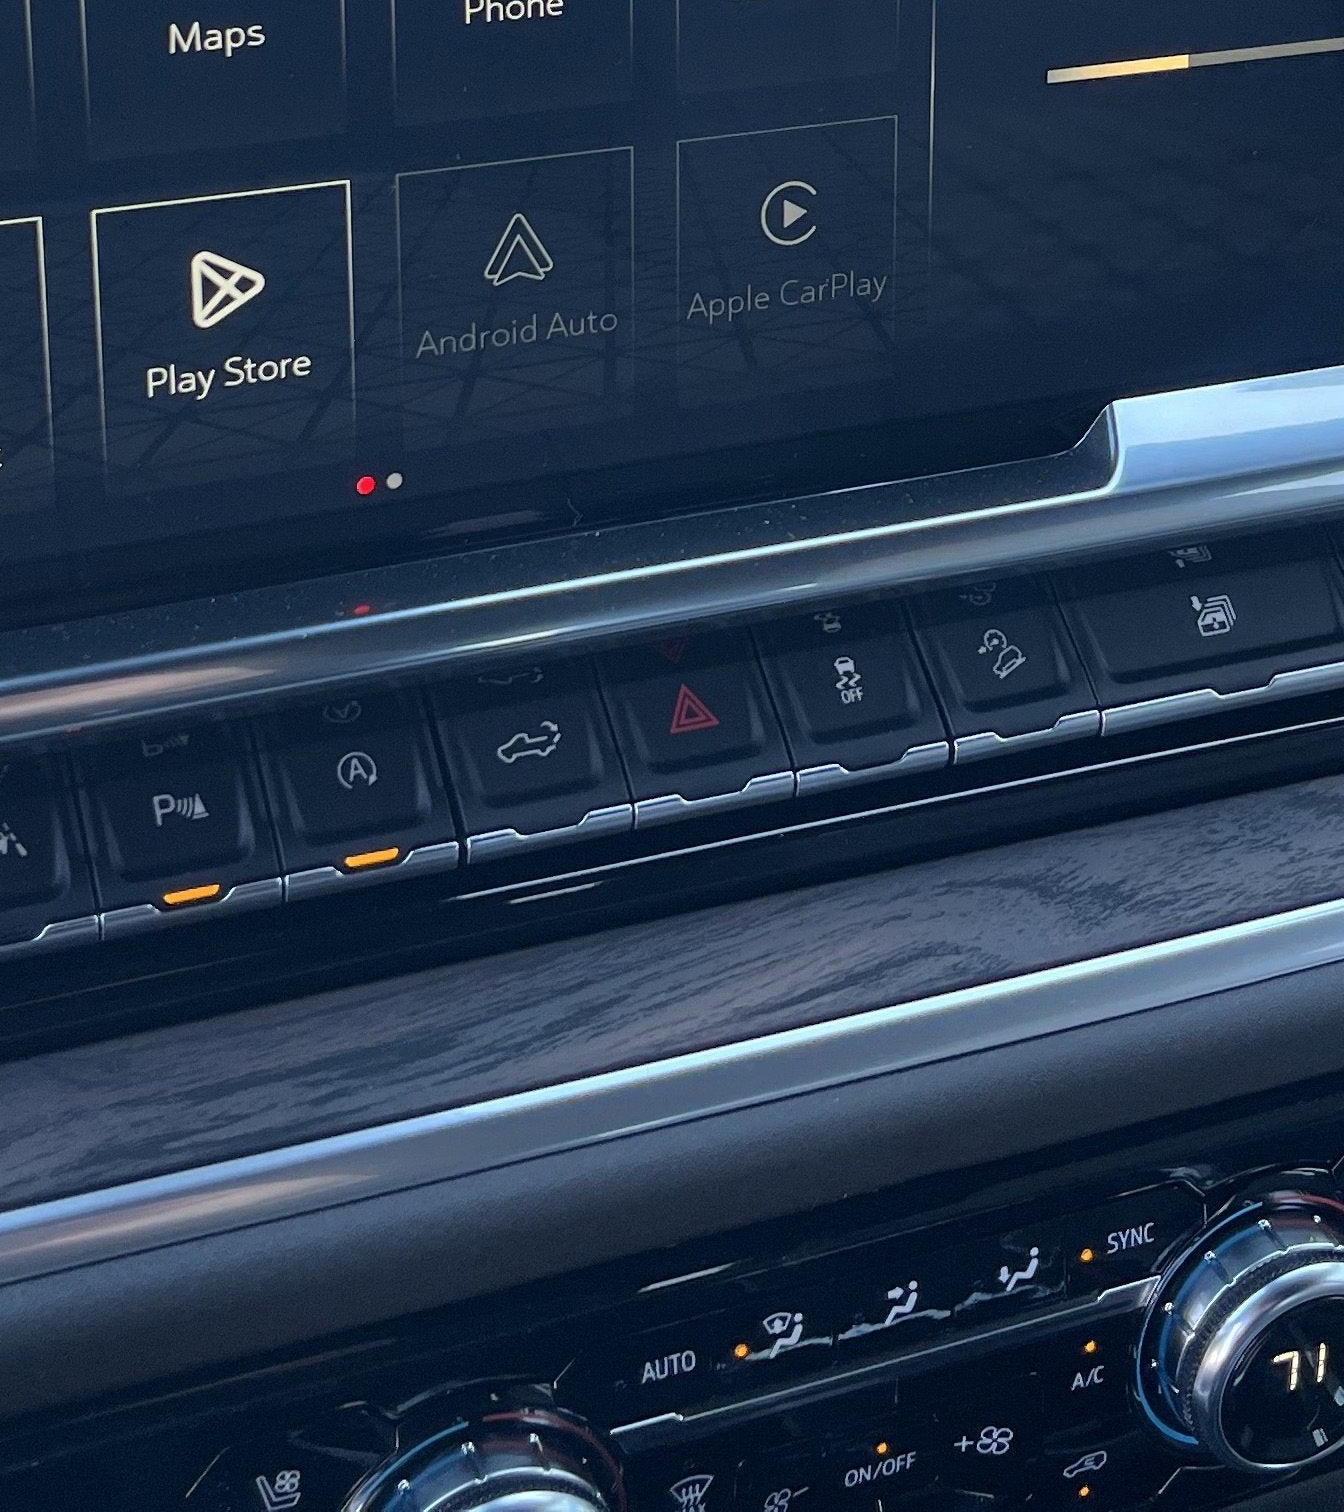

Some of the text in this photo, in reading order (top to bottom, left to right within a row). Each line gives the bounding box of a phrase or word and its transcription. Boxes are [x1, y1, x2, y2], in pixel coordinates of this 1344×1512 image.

[169, 21, 266, 58] Maps
[686, 270, 888, 321] Apple CarPlay
[415, 308, 619, 359] Android Auto
[146, 354, 312, 401] Play Store
[840, 686, 864, 704] OFF
[1106, 1221, 1156, 1256] SYNC
[641, 1349, 697, 1384] AUTO
[1071, 1365, 1105, 1391] A/C
[844, 1450, 917, 1487] ON/OFF
